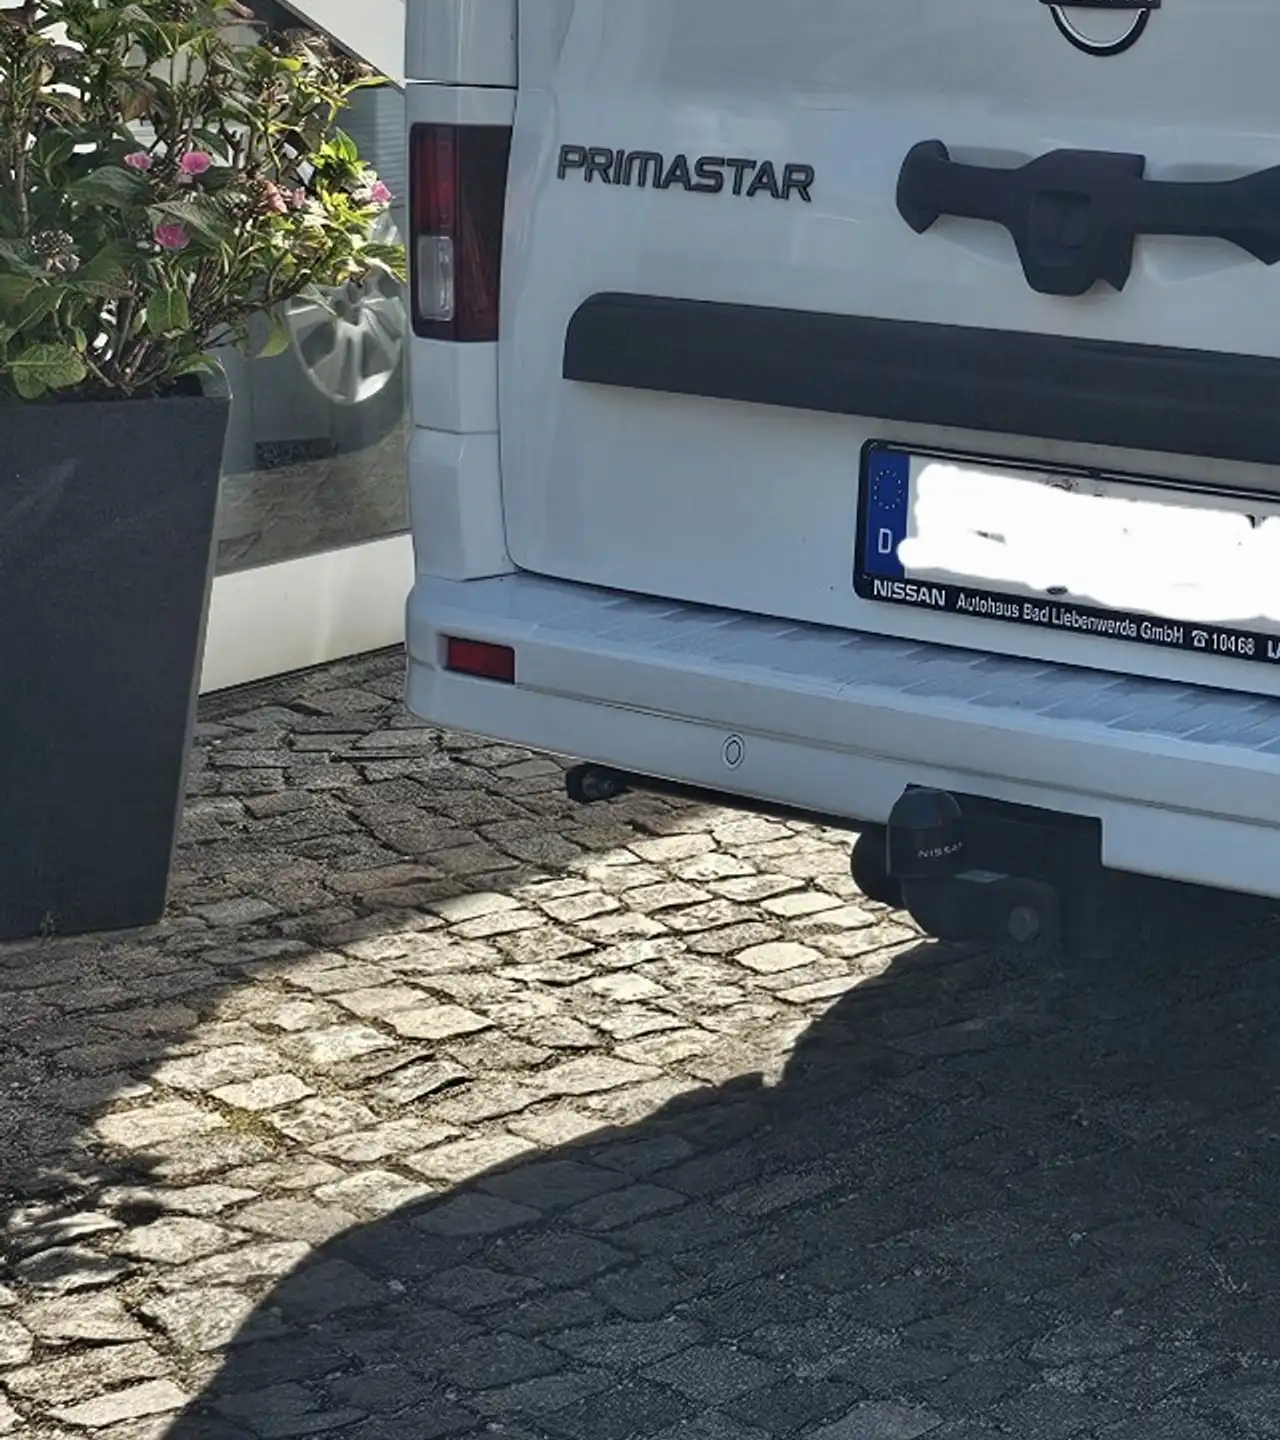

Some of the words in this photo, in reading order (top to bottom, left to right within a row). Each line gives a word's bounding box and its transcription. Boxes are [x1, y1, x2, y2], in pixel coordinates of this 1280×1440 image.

[557, 144, 815, 203] PRIMASTAR
[877, 527, 892, 554] D
[873, 579, 946, 606] NISSAN
[956, 592, 1020, 618] Autohaus
[1023, 603, 1049, 622] Bad
[1052, 608, 1138, 636] Liebenwerda
[1140, 621, 1184, 644] GmbH
